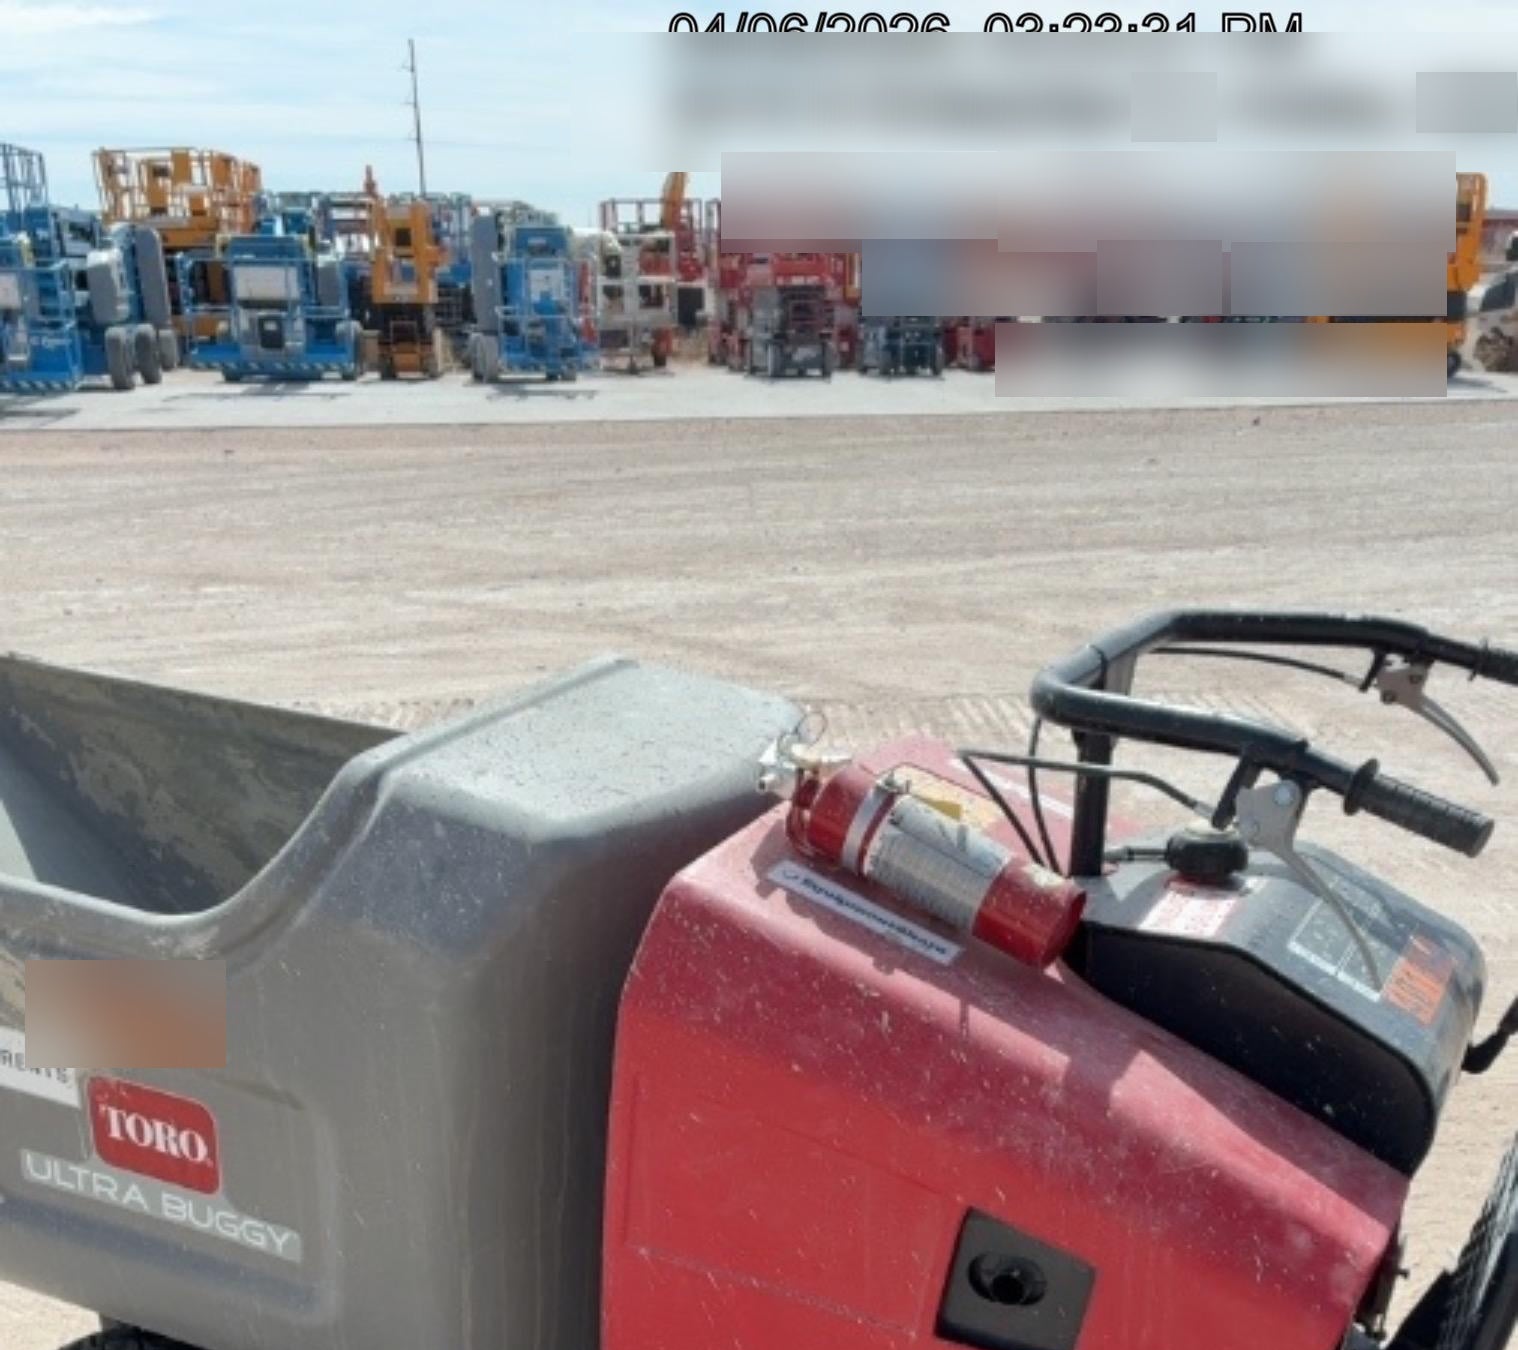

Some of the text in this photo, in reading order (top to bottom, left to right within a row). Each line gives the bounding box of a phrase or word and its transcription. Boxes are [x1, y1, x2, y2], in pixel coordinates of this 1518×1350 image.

[99, 1104, 208, 1162] TORO
[26, 1152, 291, 1252] ULTRA BUGGY
